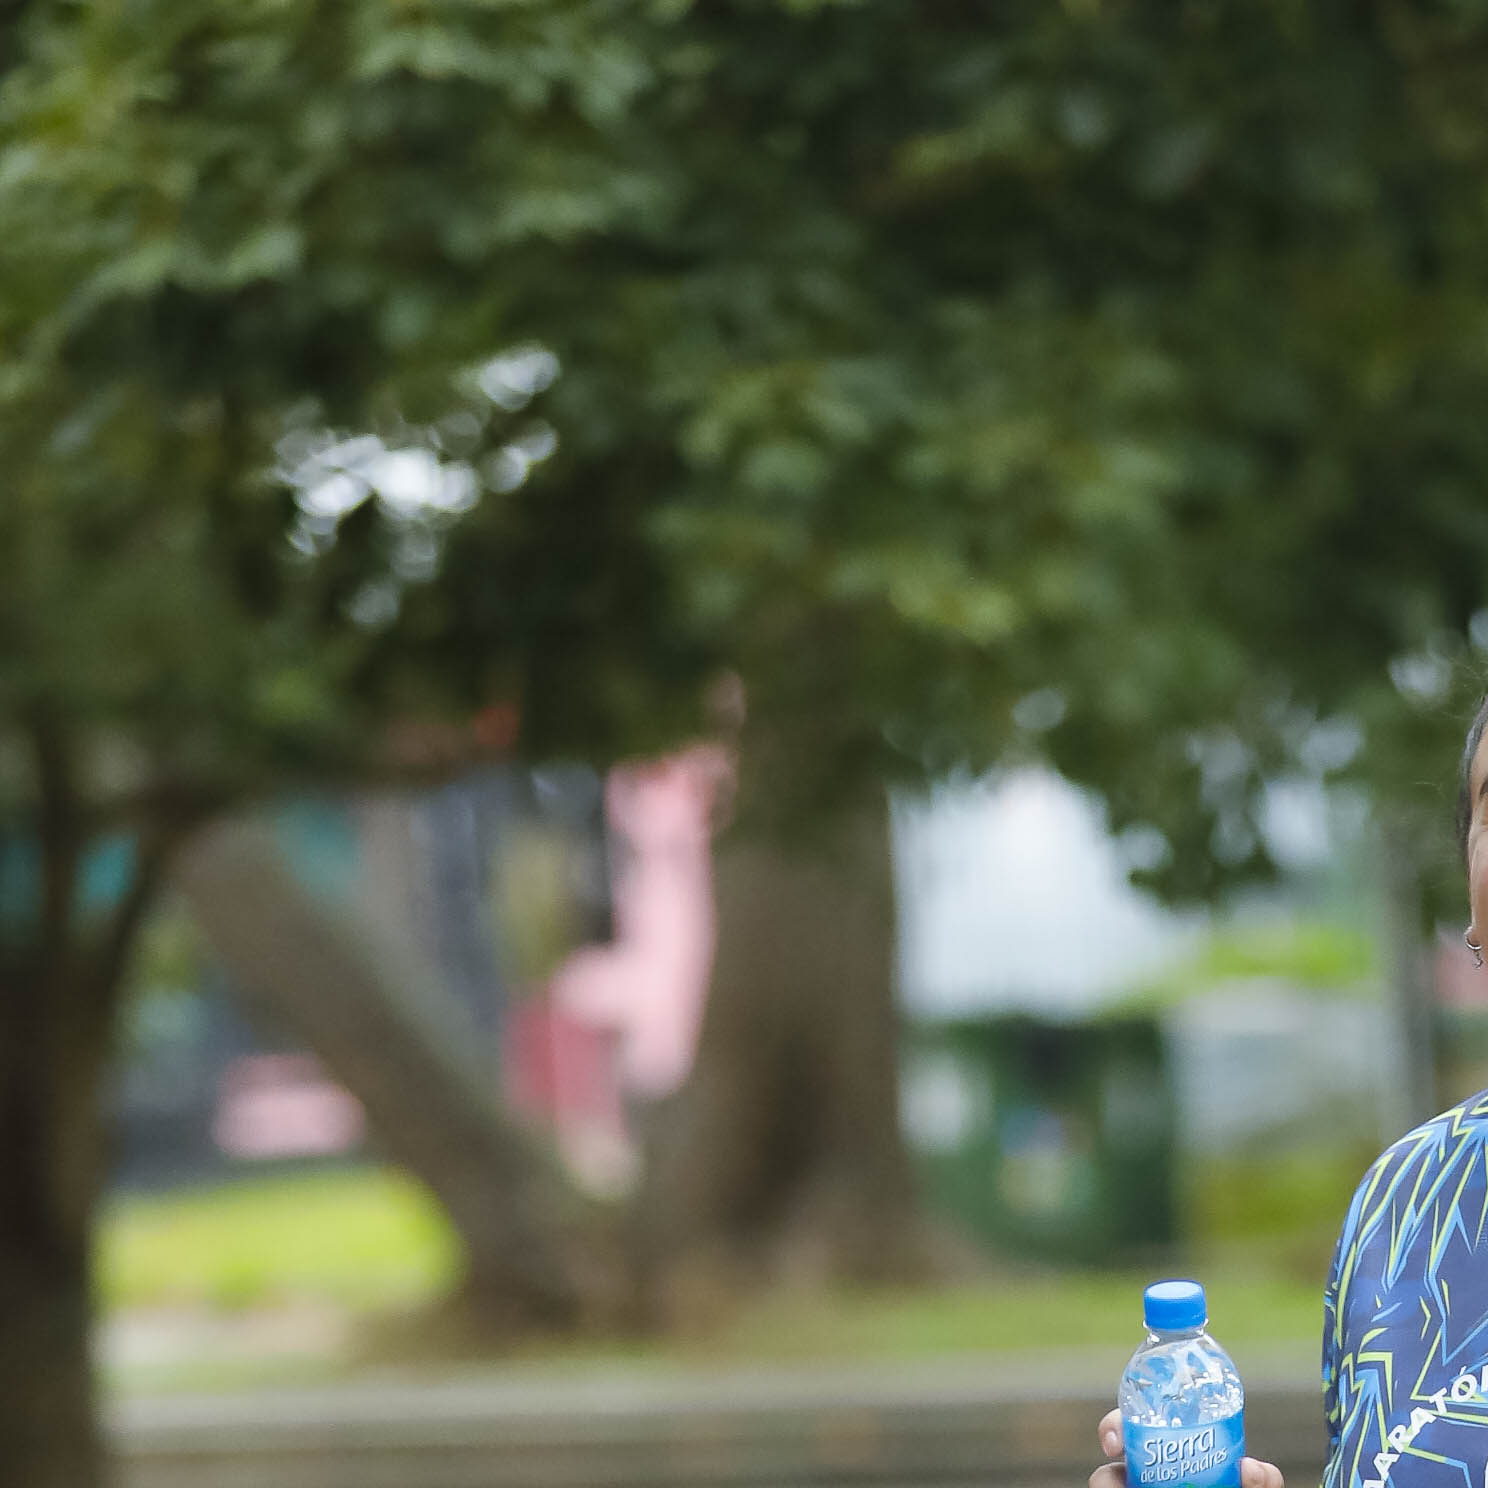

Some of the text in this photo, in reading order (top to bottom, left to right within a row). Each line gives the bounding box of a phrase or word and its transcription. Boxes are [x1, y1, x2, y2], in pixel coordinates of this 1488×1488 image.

[1144, 1425, 1215, 1466] Sierra
[1141, 1447, 1228, 1483] de los Padres
